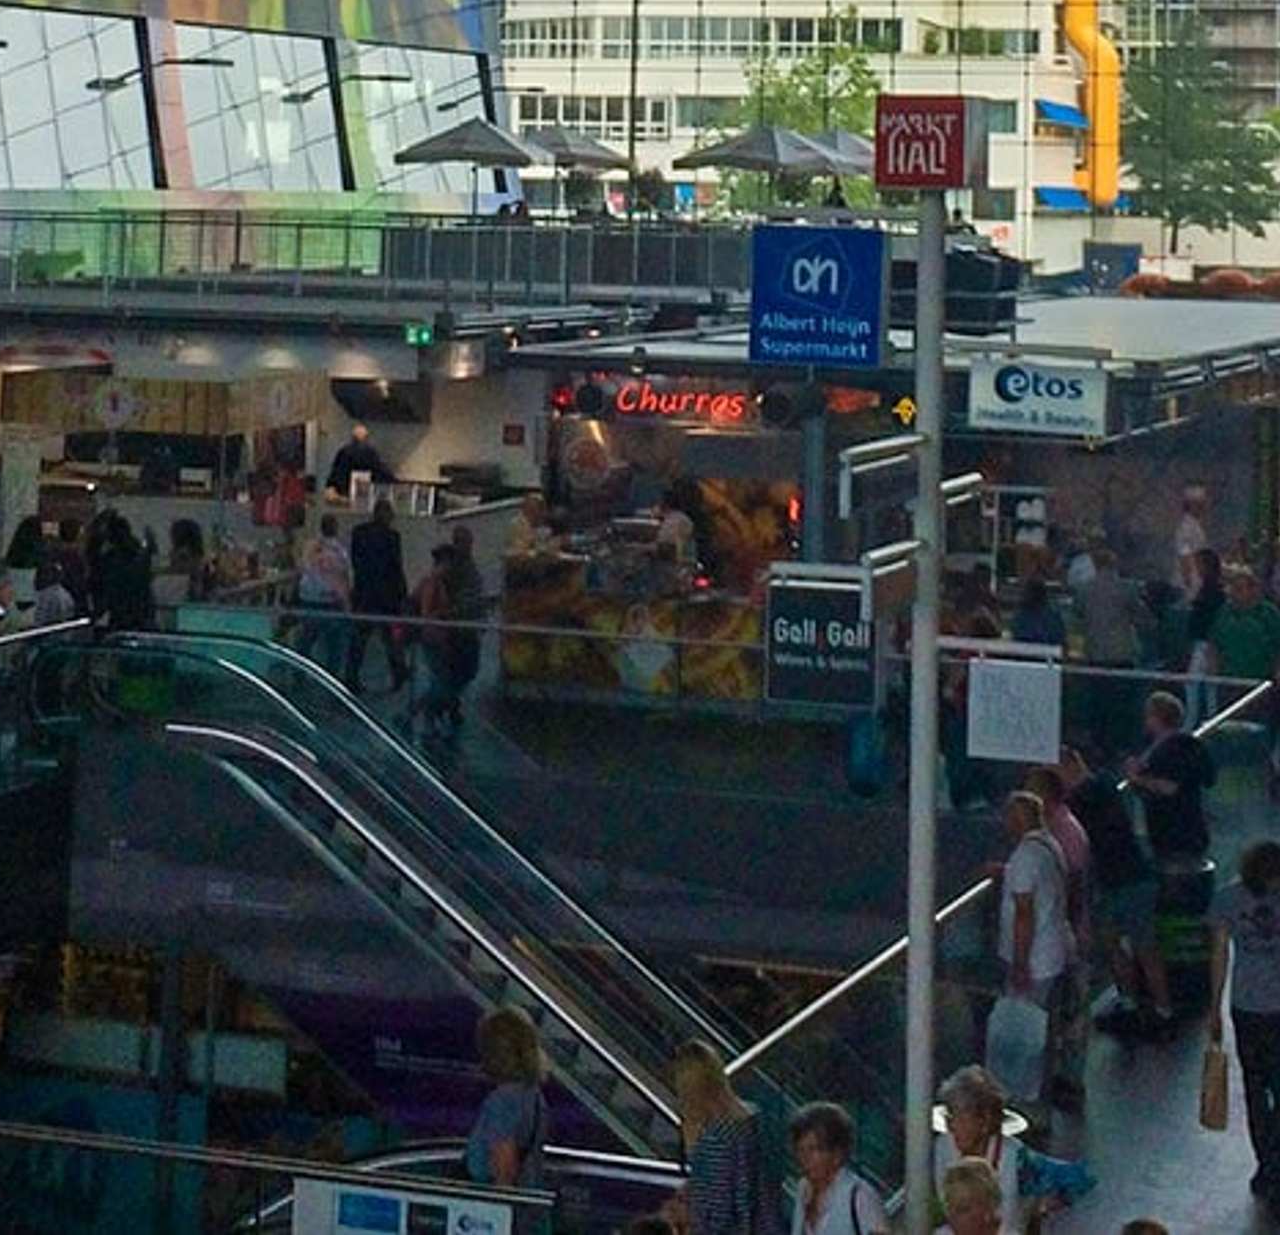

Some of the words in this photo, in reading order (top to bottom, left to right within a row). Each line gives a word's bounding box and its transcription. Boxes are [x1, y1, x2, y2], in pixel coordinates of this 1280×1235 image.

[881, 113, 959, 136] MARKT
[888, 127, 946, 174] HAL
[761, 312, 816, 331] Albert
[760, 337, 866, 358] Supermarkt
[616, 381, 746, 418] Churros
[774, 616, 816, 646] Gall
[827, 619, 872, 649] Gall
